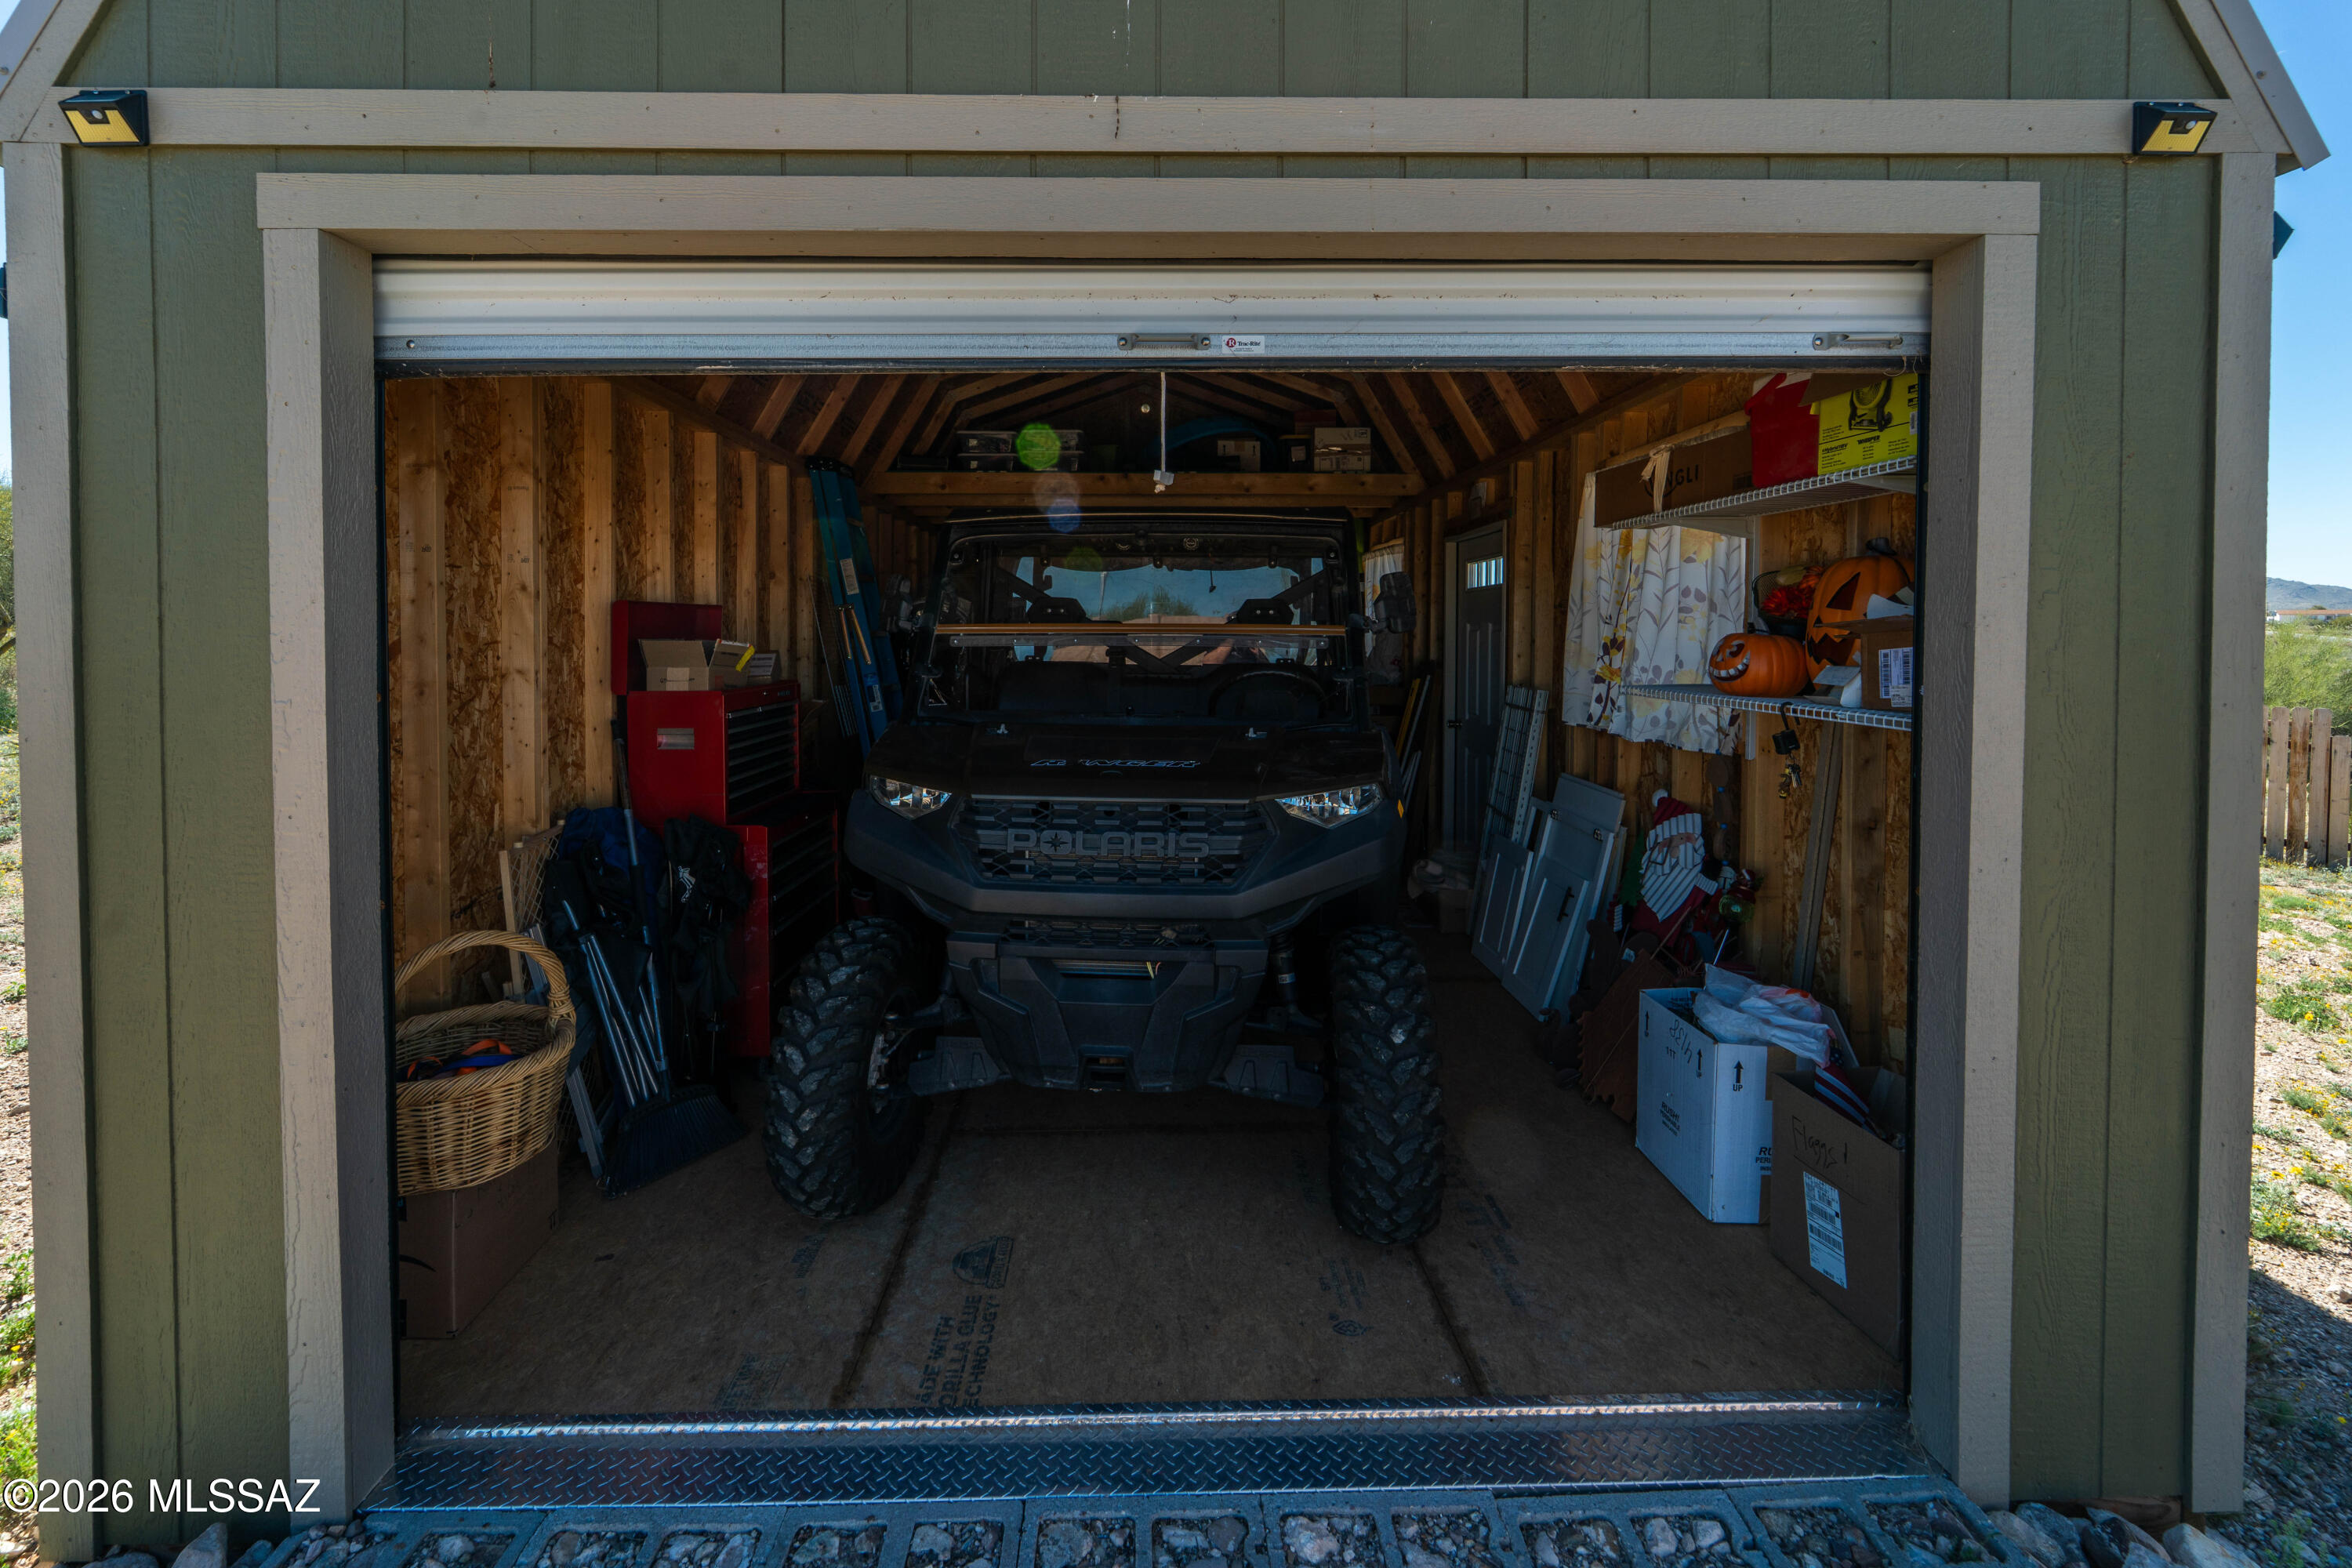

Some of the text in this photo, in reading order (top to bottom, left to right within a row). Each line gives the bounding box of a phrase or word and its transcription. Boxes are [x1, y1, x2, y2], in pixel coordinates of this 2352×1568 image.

[1857, 435, 1880, 445] WHISPER
[1029, 758, 1202, 768] RNGER
[1007, 828, 1210, 858] POLARIS
[938, 1295, 983, 1406] ORILLA GLUE
[963, 1298, 1000, 1406] ECHNOLOGY
[915, 1363, 940, 1403] ADE
